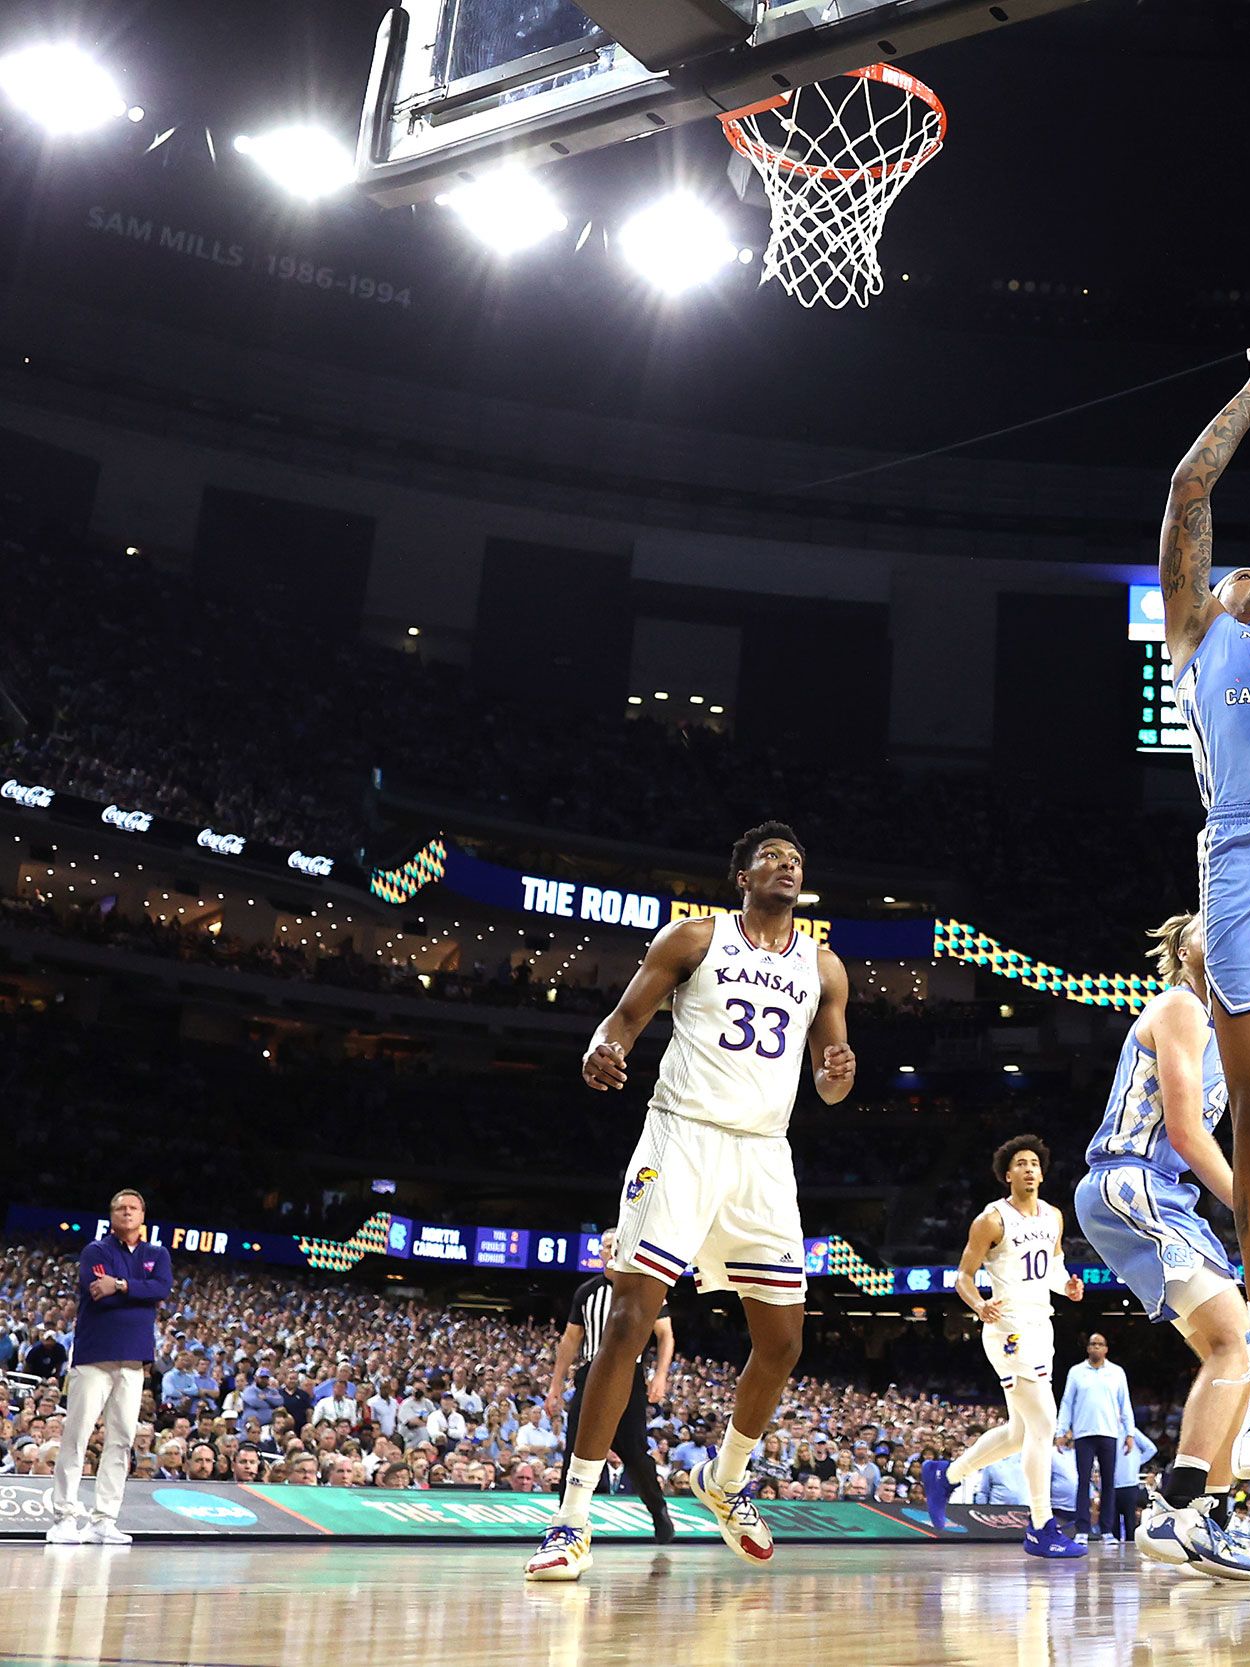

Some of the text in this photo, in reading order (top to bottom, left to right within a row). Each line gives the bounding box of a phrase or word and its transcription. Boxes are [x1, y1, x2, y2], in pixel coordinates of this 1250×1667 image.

[88, 206, 412, 307] SAM MILLS 1986-1994
[521, 876, 576, 917] THE
[580, 886, 661, 930] ROAD
[714, 966, 807, 1005] KANSAS
[718, 998, 790, 1059] 33
[172, 1228, 229, 1254] FOUR
[421, 1226, 461, 1245] NORTH
[412, 1240, 467, 1261] CAROLINA
[537, 1238, 567, 1264] 61
[1020, 1249, 1048, 1282] 10
[361, 1500, 460, 1523] THE
[443, 1502, 554, 1524] ROAD
